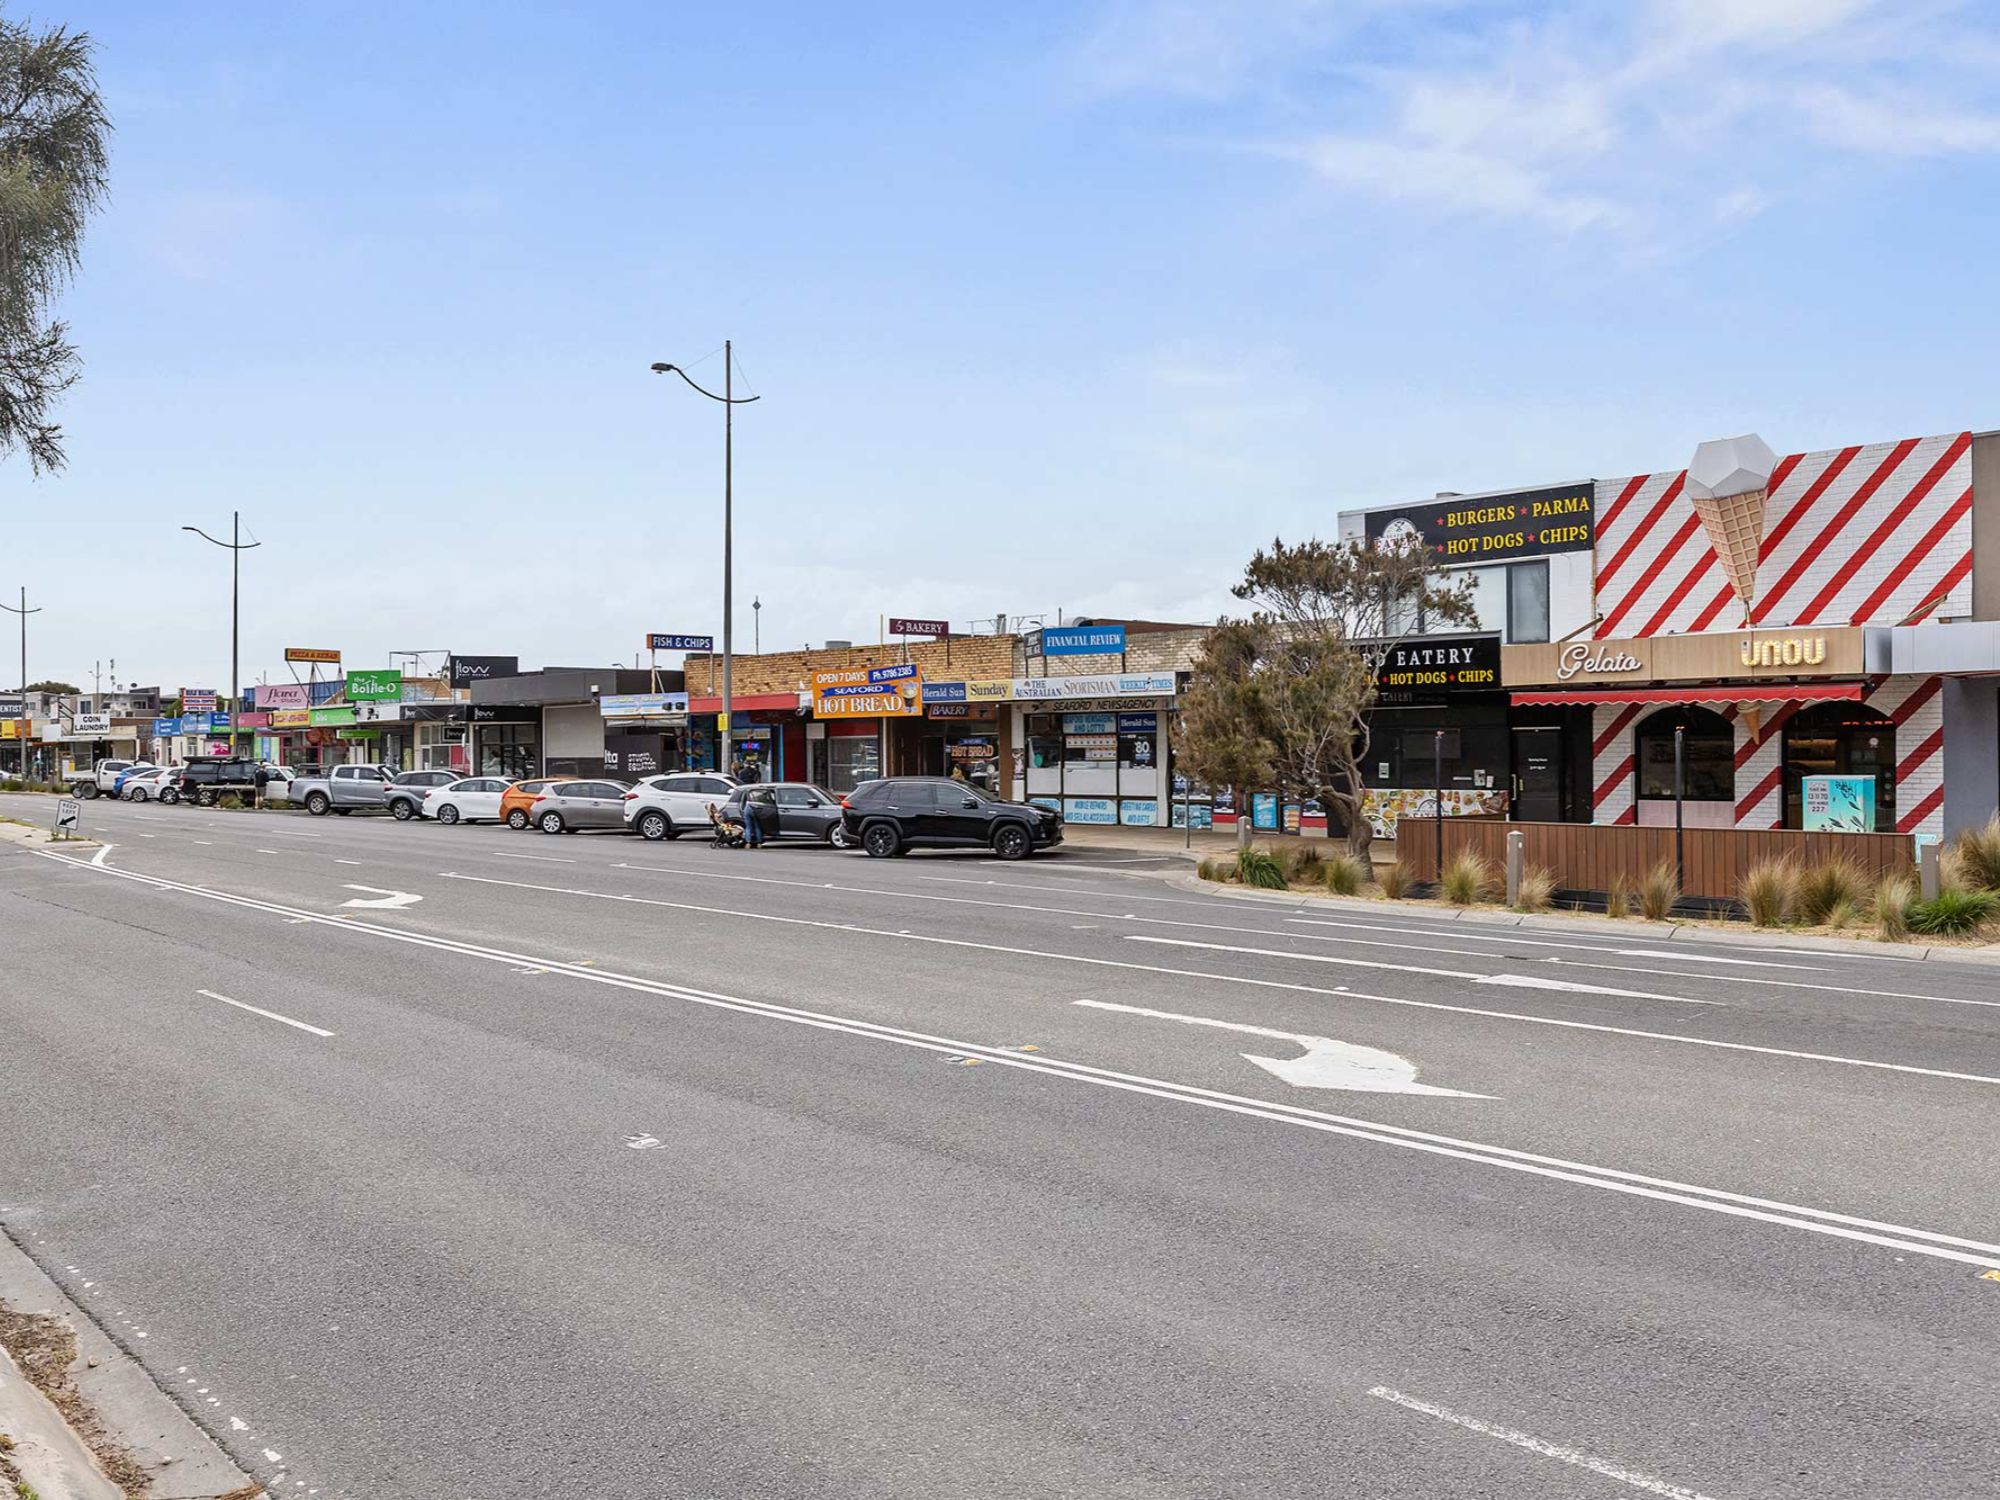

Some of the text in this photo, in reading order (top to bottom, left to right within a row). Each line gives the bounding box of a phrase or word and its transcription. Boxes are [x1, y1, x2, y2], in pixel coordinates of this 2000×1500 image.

[1447, 497, 1590, 527] BURGERS PARMA
[1448, 525, 1588, 554] HOT DOGS CHIPS
[905, 622, 943, 634] BAKERY
[653, 636, 711, 648] FISH & CHIPS
[1046, 635, 1089, 647] FINANCIAL
[1090, 633, 1121, 646] REVIEW
[1397, 648, 1474, 666] EATERY
[1557, 643, 1642, 680] Gelato
[816, 671, 866, 684] OPEN 7 DAYS
[1390, 673, 1413, 685] HOT
[1416, 672, 1447, 684] DOGS
[1458, 669, 1494, 683] CHIPS
[834, 685, 884, 695] SEAFORD
[970, 683, 1009, 697] Sunday
[1031, 680, 1047, 689] THE
[923, 687, 964, 698] Herald Sun
[1015, 687, 1062, 698] AUSTRALIAN
[817, 696, 902, 714] HOT BREAD
[932, 705, 968, 716] BAKERY
[1052, 699, 1158, 711] SEAFORD NEWSAGENCY
[75, 723, 109, 732] LAUNDRY
